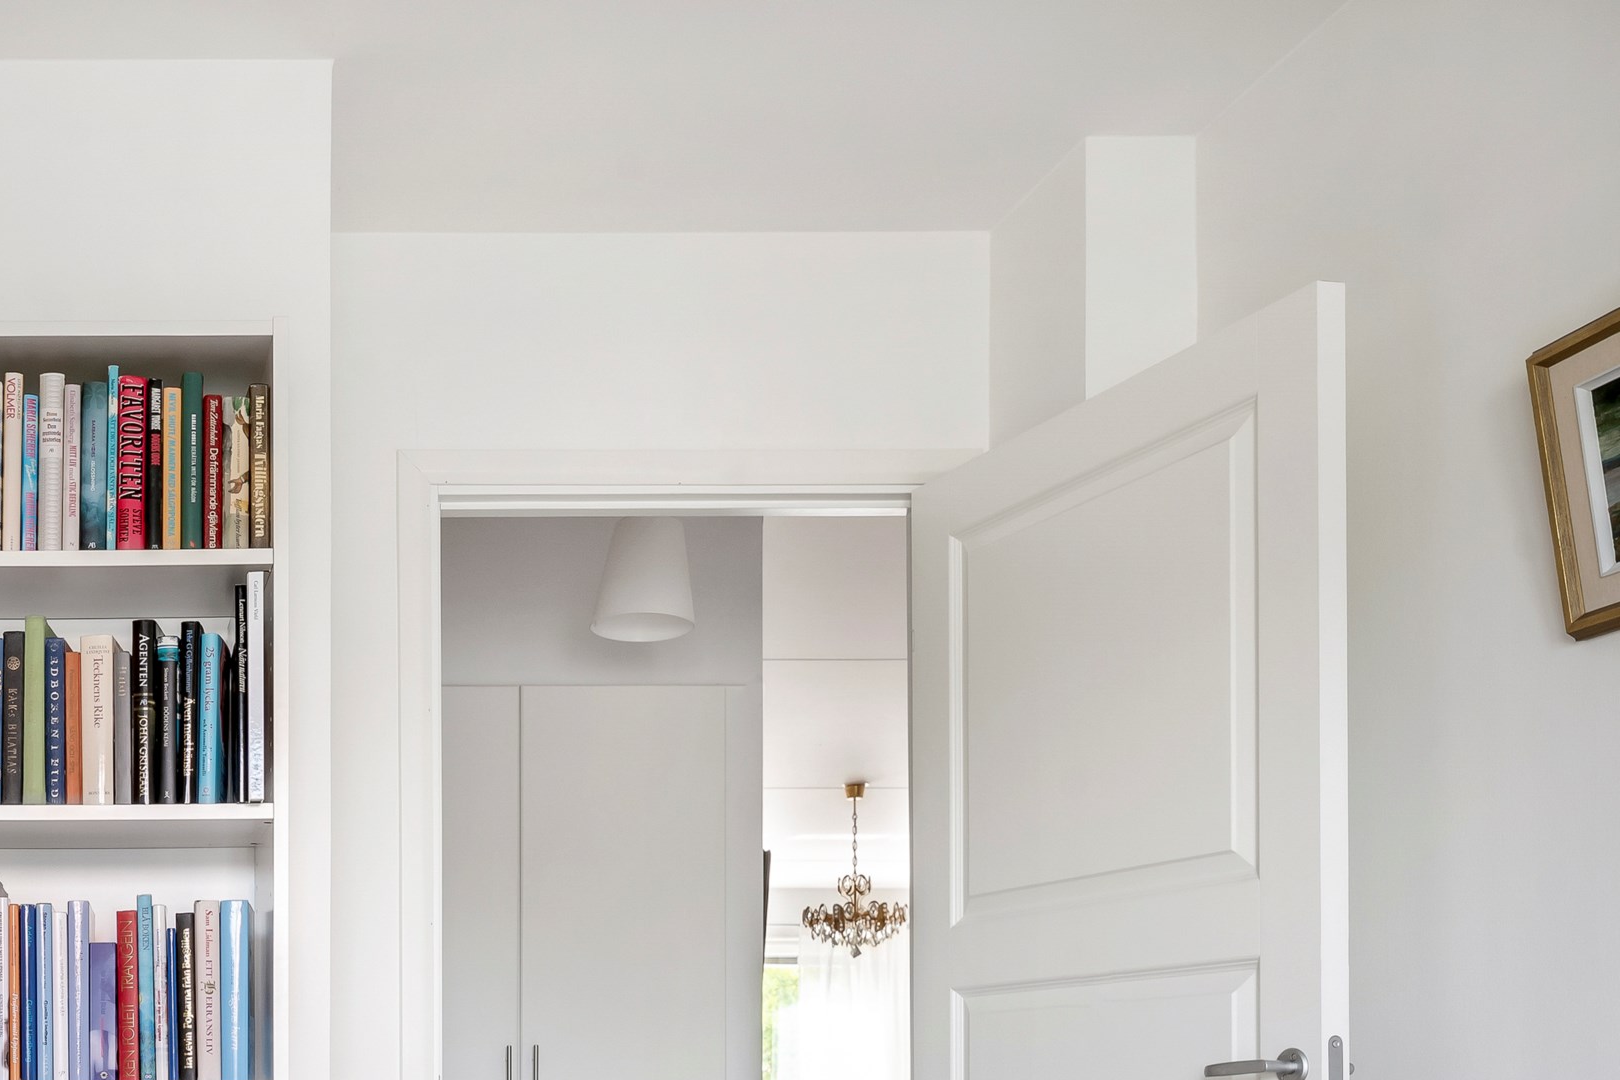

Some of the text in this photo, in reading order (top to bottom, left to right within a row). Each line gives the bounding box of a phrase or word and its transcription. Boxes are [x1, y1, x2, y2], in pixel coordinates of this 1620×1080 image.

[7, 378, 15, 418] VOLMER
[119, 384, 144, 501] FAVORITEN
[94, 656, 103, 728] Tecknens Rike
[204, 647, 214, 711] 25 gram lycka
[139, 634, 149, 797] AGENTEN JOHN GRISHAM
[142, 907, 150, 922] BLÅ
[123, 1003, 135, 1045] FOLLETT
[125, 1050, 135, 1077] KEN
